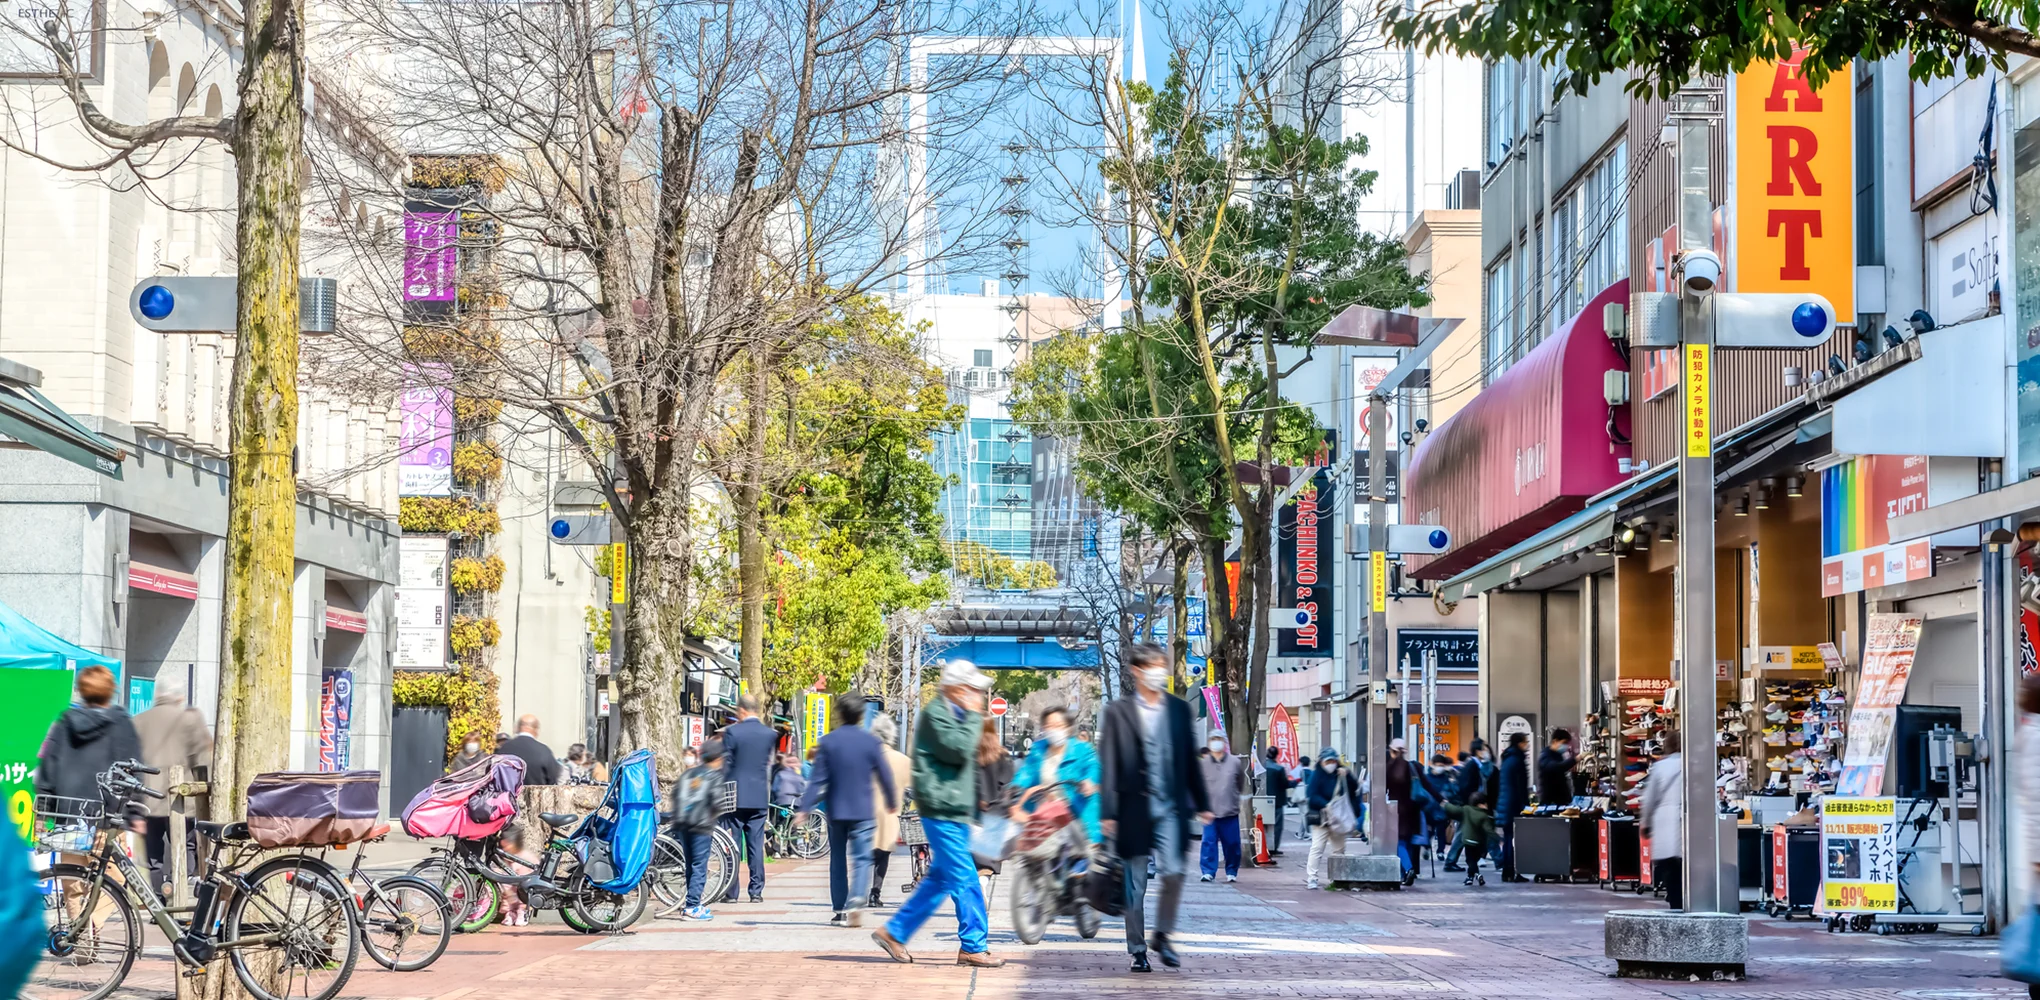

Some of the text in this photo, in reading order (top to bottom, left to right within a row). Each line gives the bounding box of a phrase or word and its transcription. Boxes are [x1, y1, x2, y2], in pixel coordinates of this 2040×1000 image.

[18, 8, 74, 18] ESTHEC
[1692, 349, 1704, 440] 防犯カメラ作動中
[1297, 490, 1317, 585] PACHINKO
[1297, 586, 1312, 599] &
[1297, 601, 1318, 649] SOT
[1404, 639, 1478, 650] ブランド時計・ブ
[1865, 655, 1886, 676] au
[1825, 824, 1846, 834] 11/11
[1868, 838, 1881, 882] スマホ
[1882, 822, 1894, 883] プリペイド
